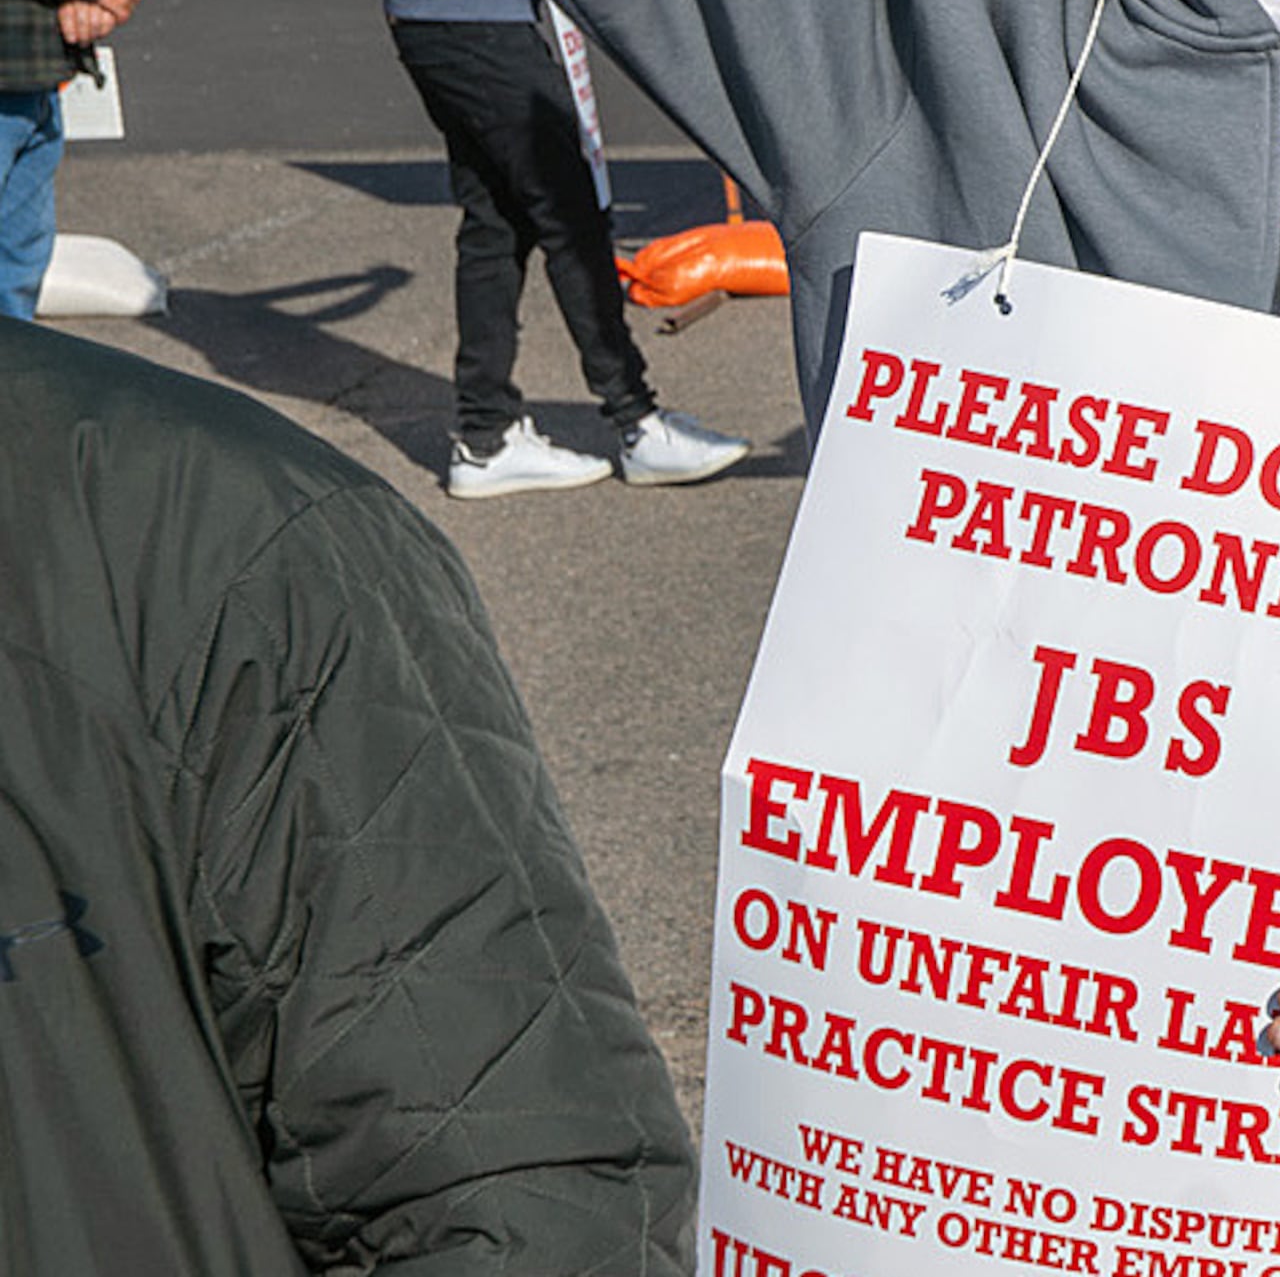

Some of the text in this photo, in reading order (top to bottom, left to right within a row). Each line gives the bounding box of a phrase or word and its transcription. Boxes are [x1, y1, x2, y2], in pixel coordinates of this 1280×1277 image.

[846, 350, 1170, 482] PLEASE
[1009, 645, 1232, 778] JBS
[733, 889, 837, 971] ON
[857, 918, 1139, 1041] UNFAIR
[726, 983, 1105, 1136] PRACTICE
[724, 1141, 824, 1211] WITH
[832, 1184, 926, 1237] ANY
[935, 1213, 1101, 1275] OTHER
[797, 1124, 866, 1177] WE
[874, 1146, 993, 1208] HAVE
[1004, 1178, 1078, 1224] NO
